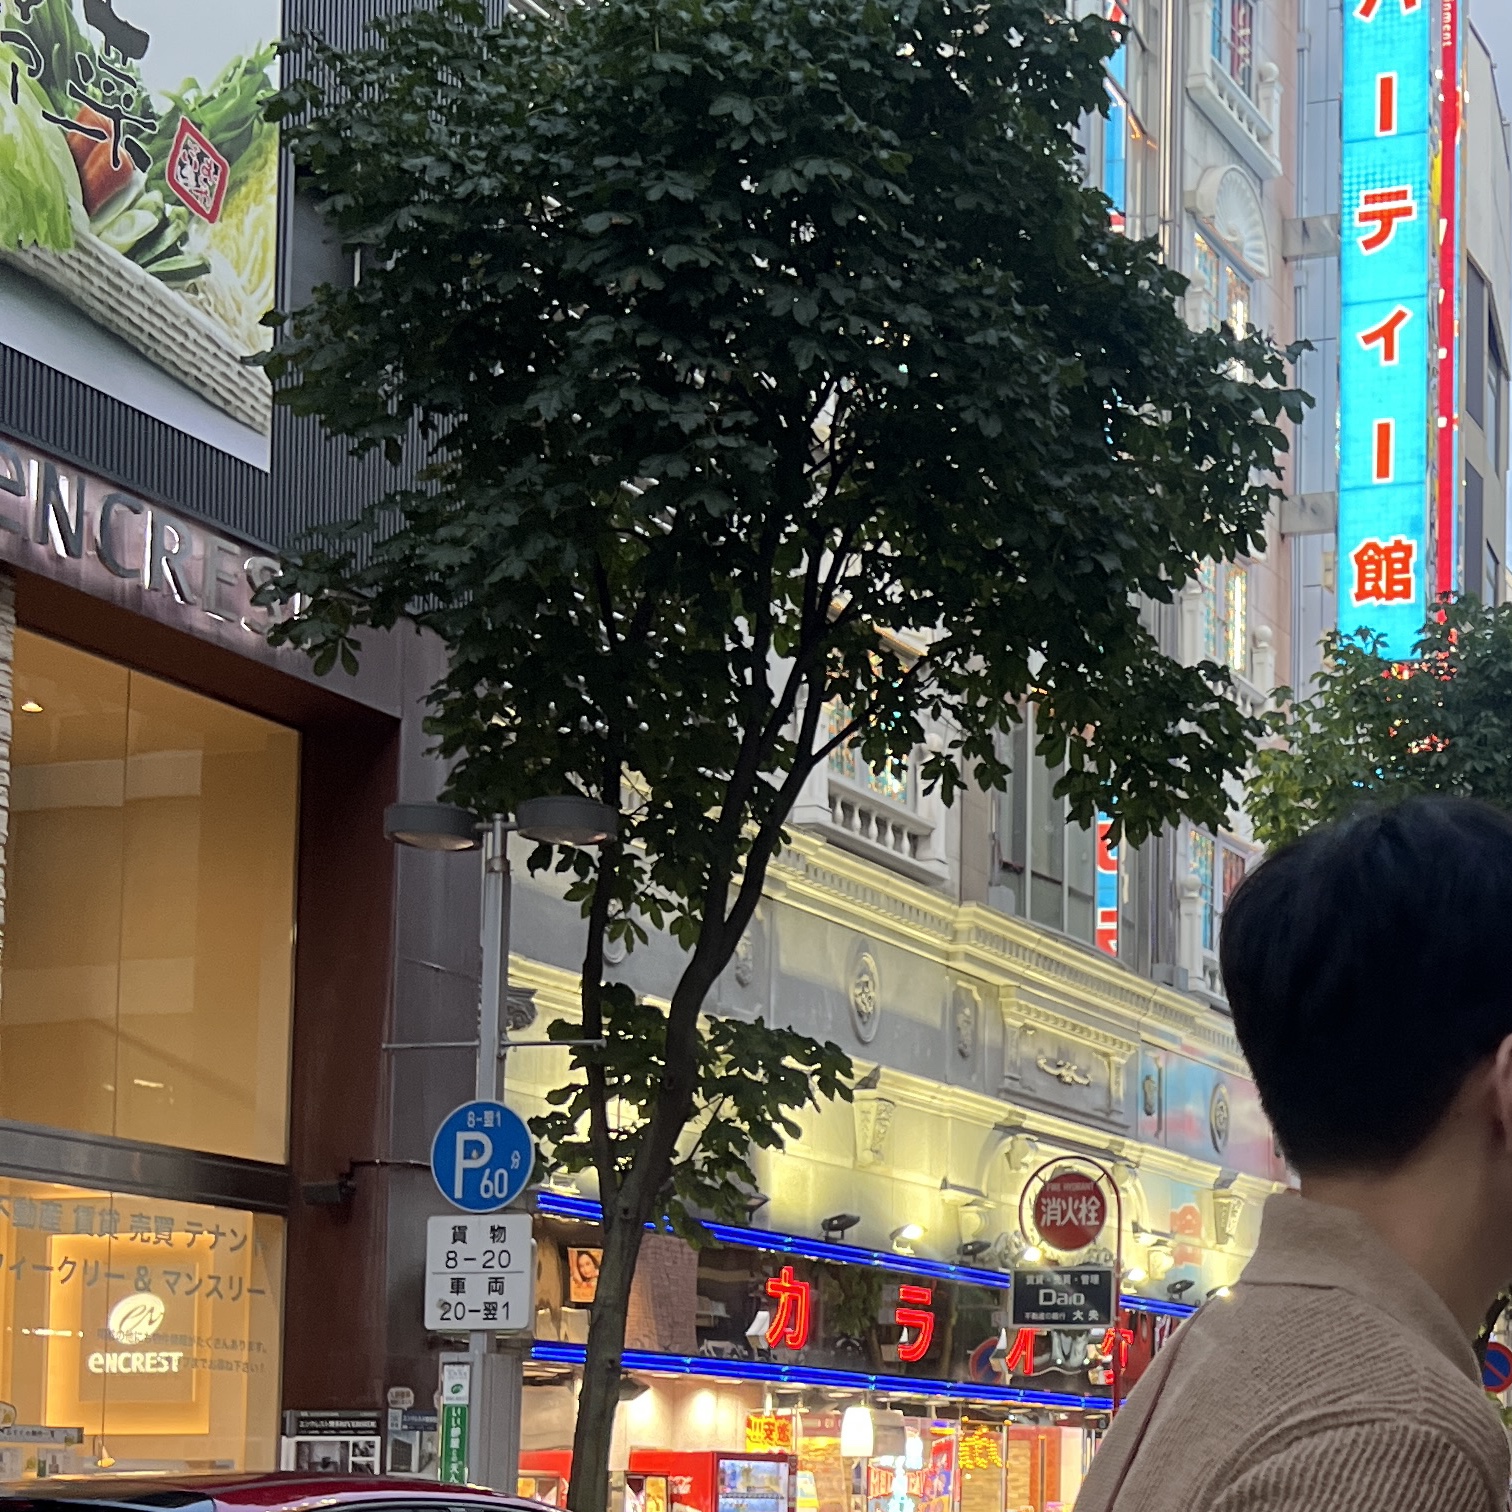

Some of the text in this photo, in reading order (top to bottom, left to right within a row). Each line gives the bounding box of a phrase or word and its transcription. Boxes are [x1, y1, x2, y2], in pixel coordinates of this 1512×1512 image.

[1442, 0, 1453, 48] nment
[0, 438, 313, 645] NCRES
[454, 1131, 493, 1199] P
[480, 1168, 508, 1199] 60
[1040, 1196, 1101, 1227] 消火栓
[130, 1212, 175, 1248] 売買
[445, 1250, 511, 1270] 8-20
[134, 1265, 150, 1292] &
[162, 1270, 266, 1301] マンスリー
[1038, 1288, 1086, 1306] Daio
[439, 1301, 510, 1321] 20-翌1
